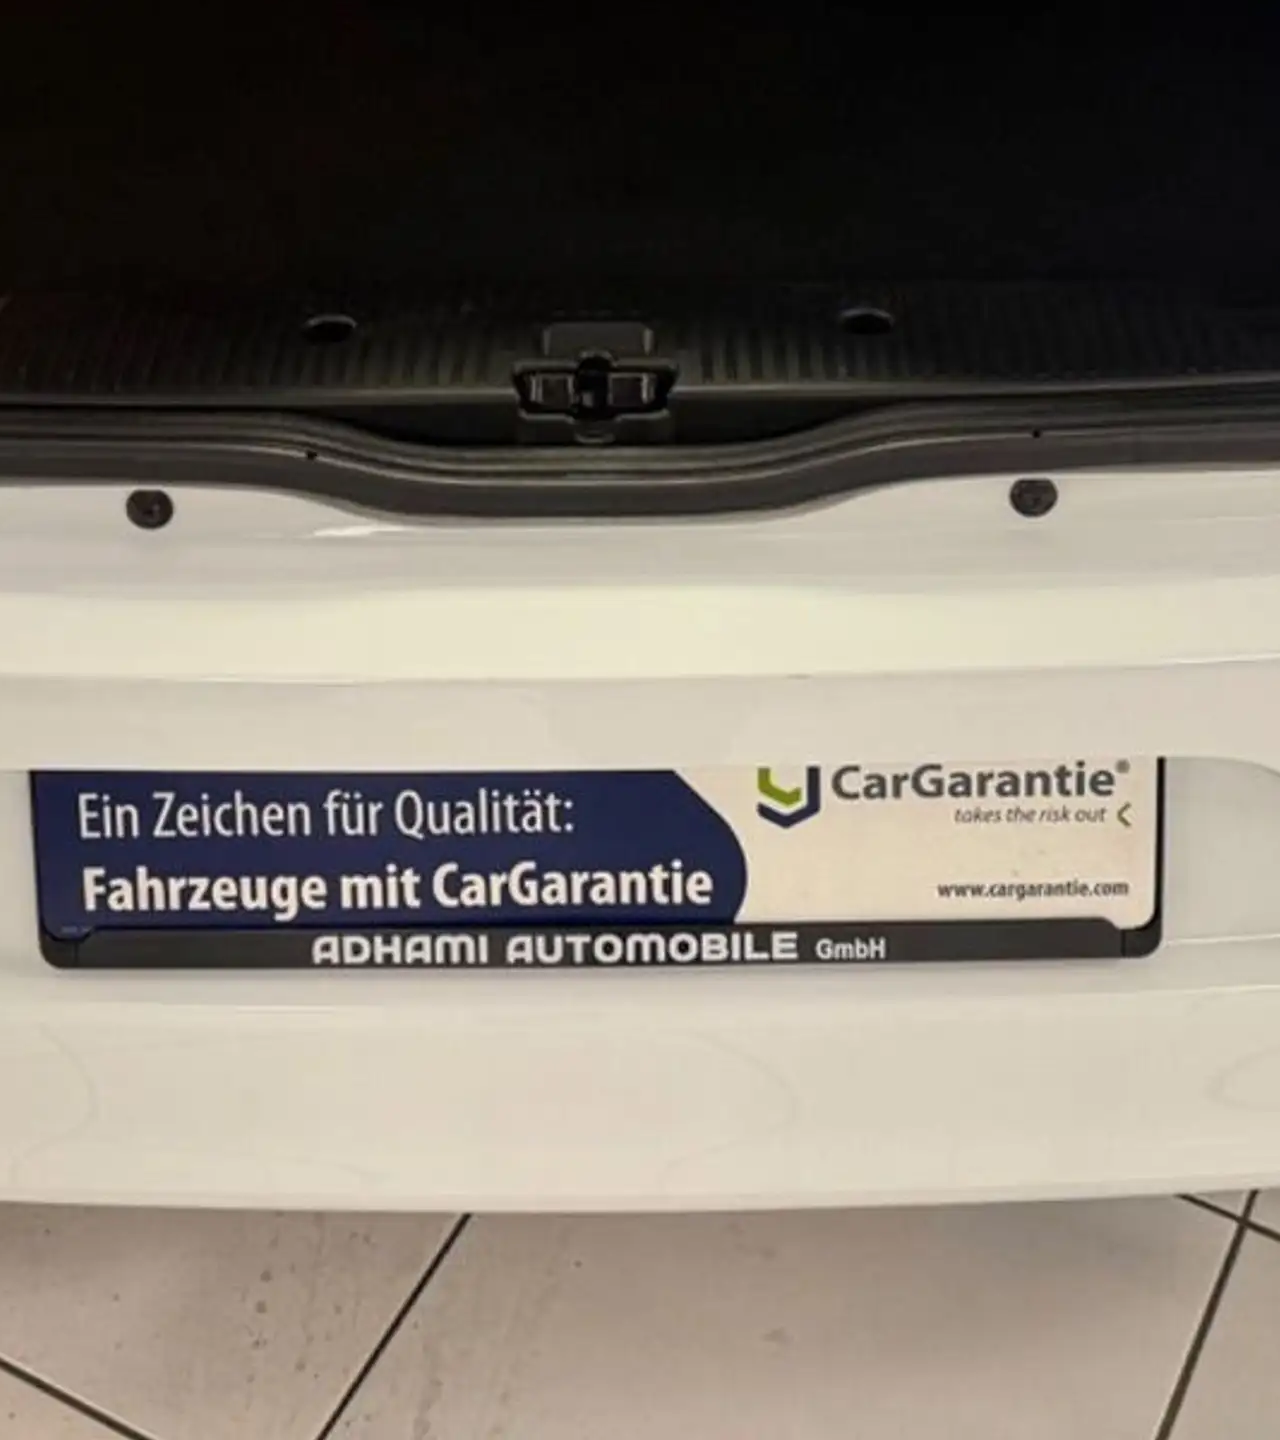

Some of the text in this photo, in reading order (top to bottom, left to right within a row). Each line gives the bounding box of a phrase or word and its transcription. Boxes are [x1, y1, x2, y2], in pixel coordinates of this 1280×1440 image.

[78, 788, 574, 839] Ein Zeichen für Qualität:
[954, 805, 1107, 824] takes the risk out
[82, 859, 714, 922] Fahrzeuge mit CarGarantie
[937, 880, 1129, 899] www.cargarantie.com
[312, 932, 887, 965] ADHAMI AUTOMOBILE GmbH
